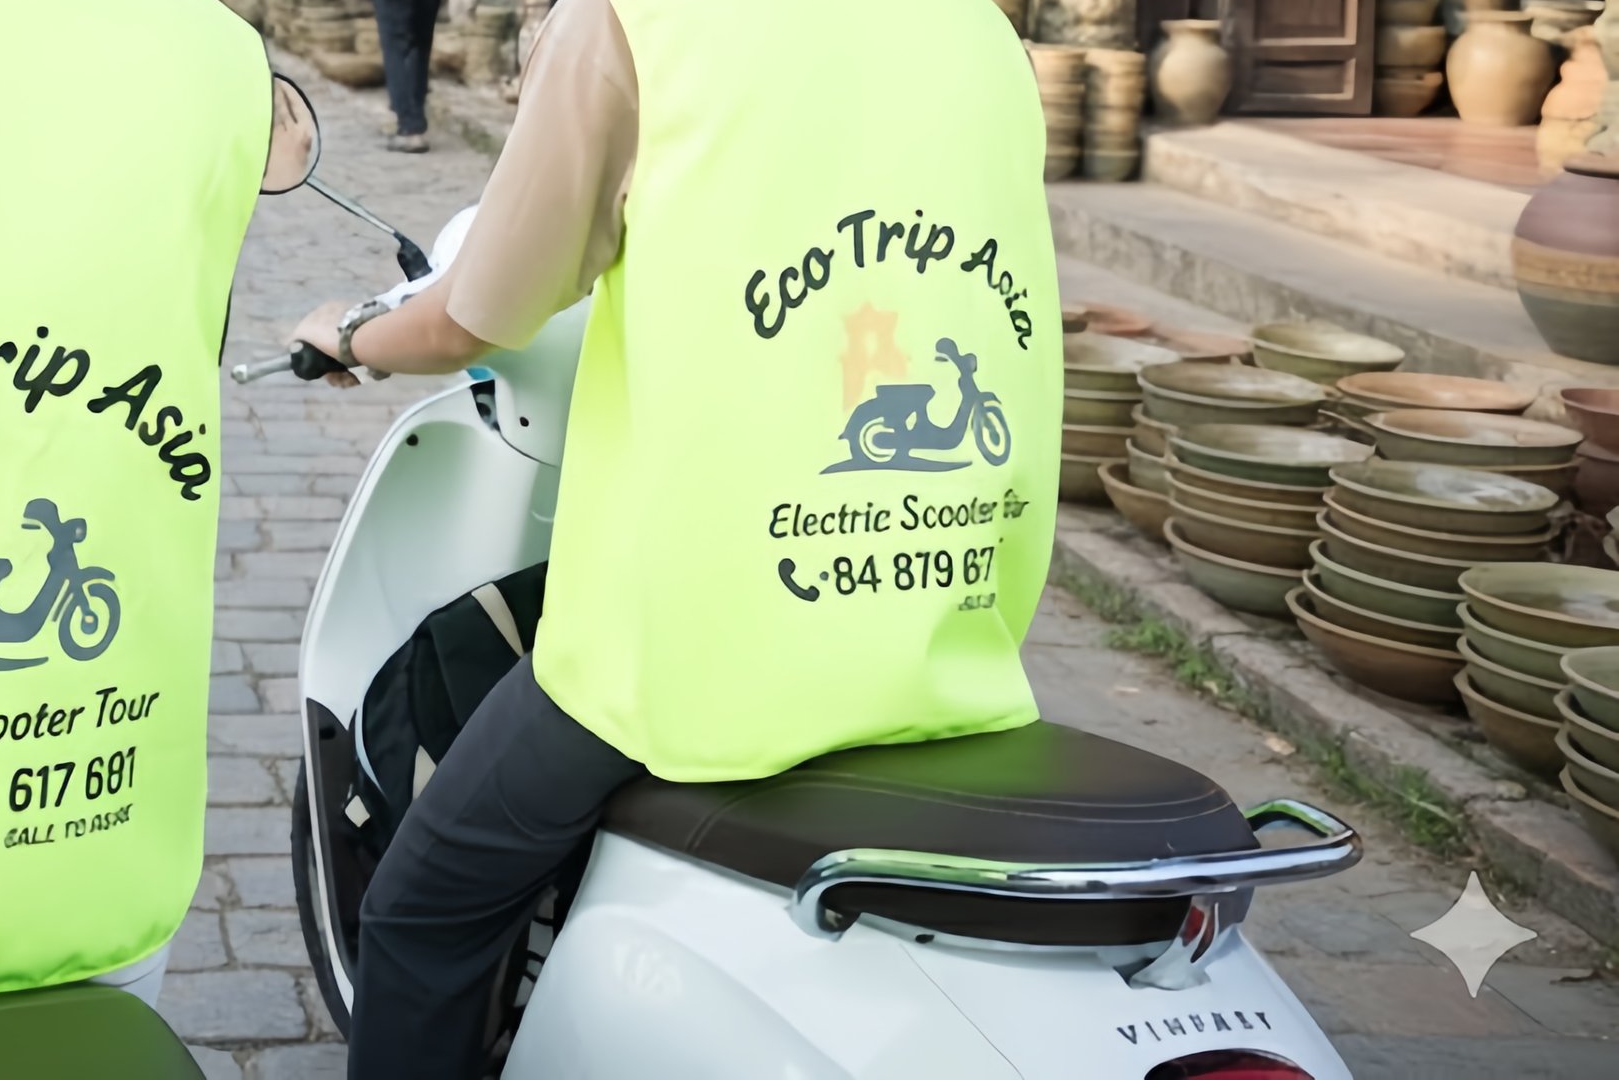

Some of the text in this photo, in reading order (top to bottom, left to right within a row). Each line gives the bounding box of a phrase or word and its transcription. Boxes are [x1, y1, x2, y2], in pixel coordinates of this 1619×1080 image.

[745, 247, 834, 339] Eco
[837, 210, 955, 274] Trip
[86, 364, 212, 501] Asia
[769, 502, 891, 538] Electric
[893, 550, 953, 590] 879
[95, 686, 160, 727] Tour
[9, 762, 75, 812] 617
[85, 746, 136, 800] 681
